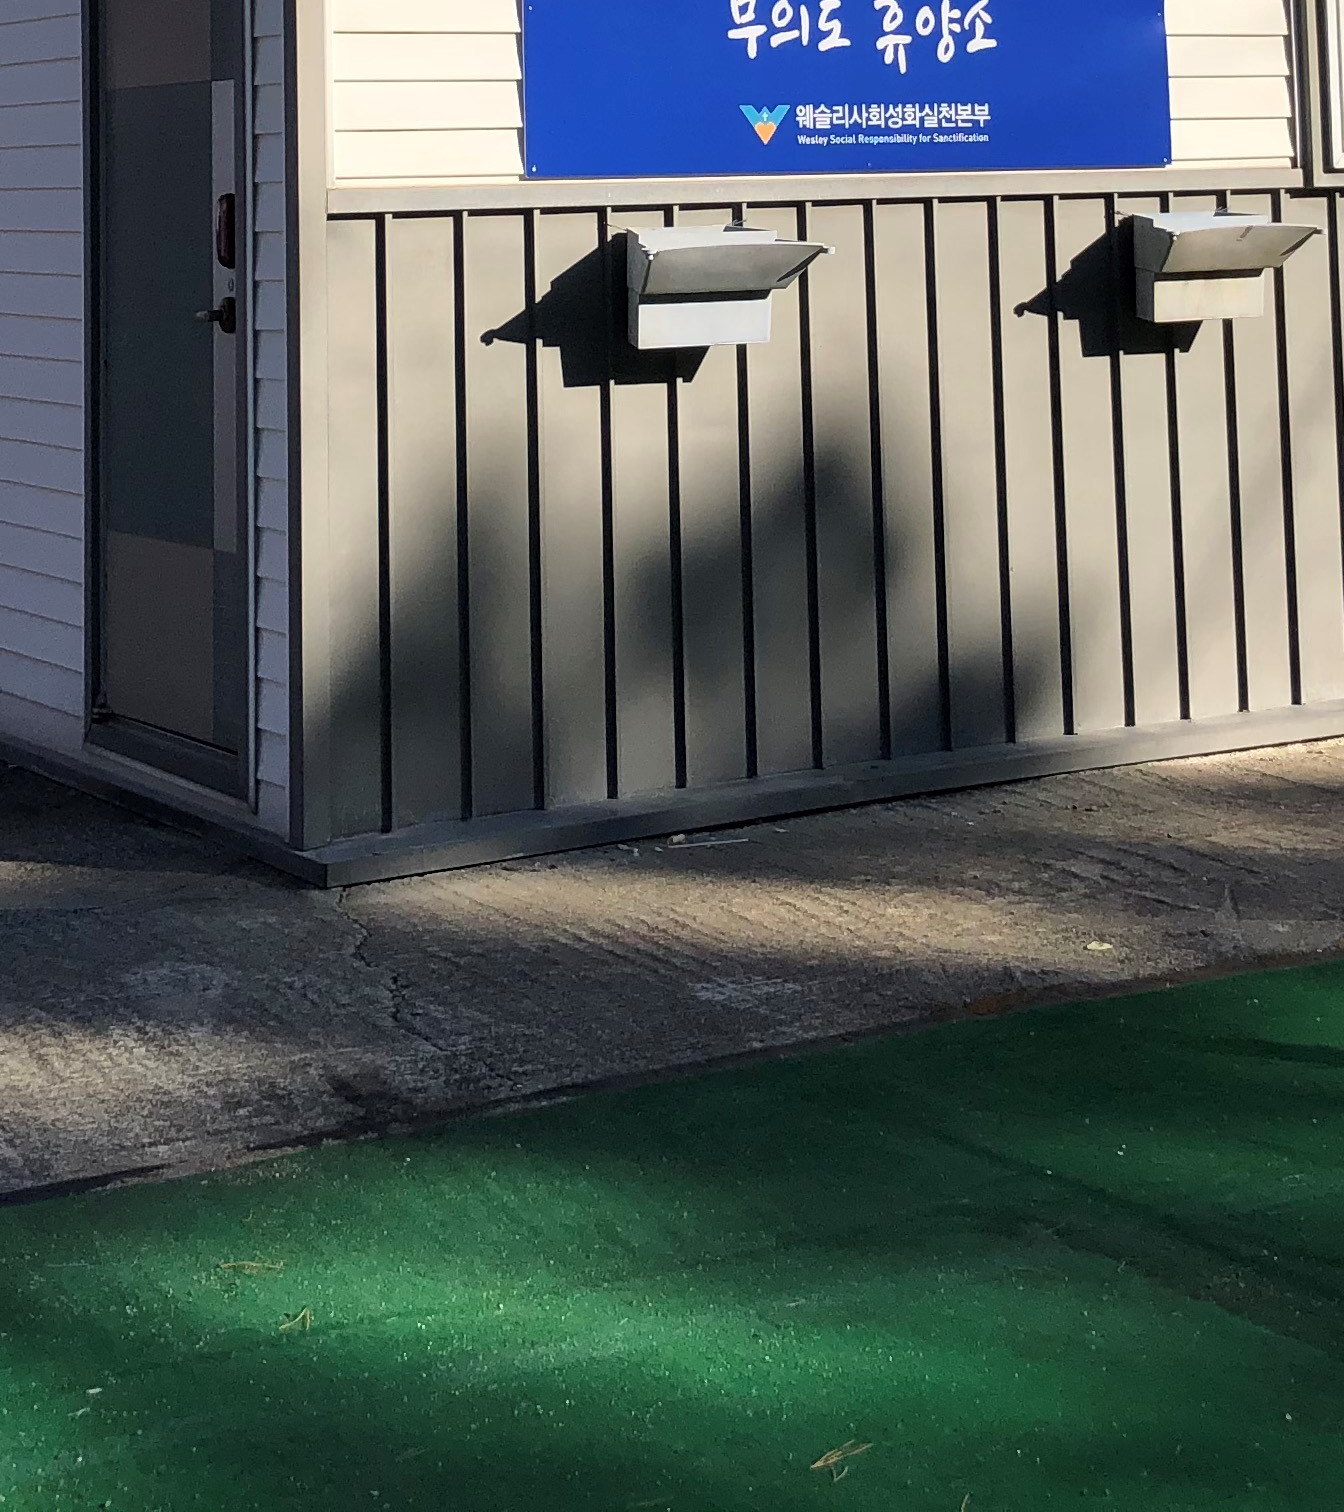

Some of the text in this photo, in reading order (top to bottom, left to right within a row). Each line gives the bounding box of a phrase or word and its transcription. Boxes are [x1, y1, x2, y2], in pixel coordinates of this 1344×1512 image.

[796, 103, 991, 129] 웨슬리사회성화실천본부
[797, 133, 989, 146] Wesley Social Responsibility for Sanctification
